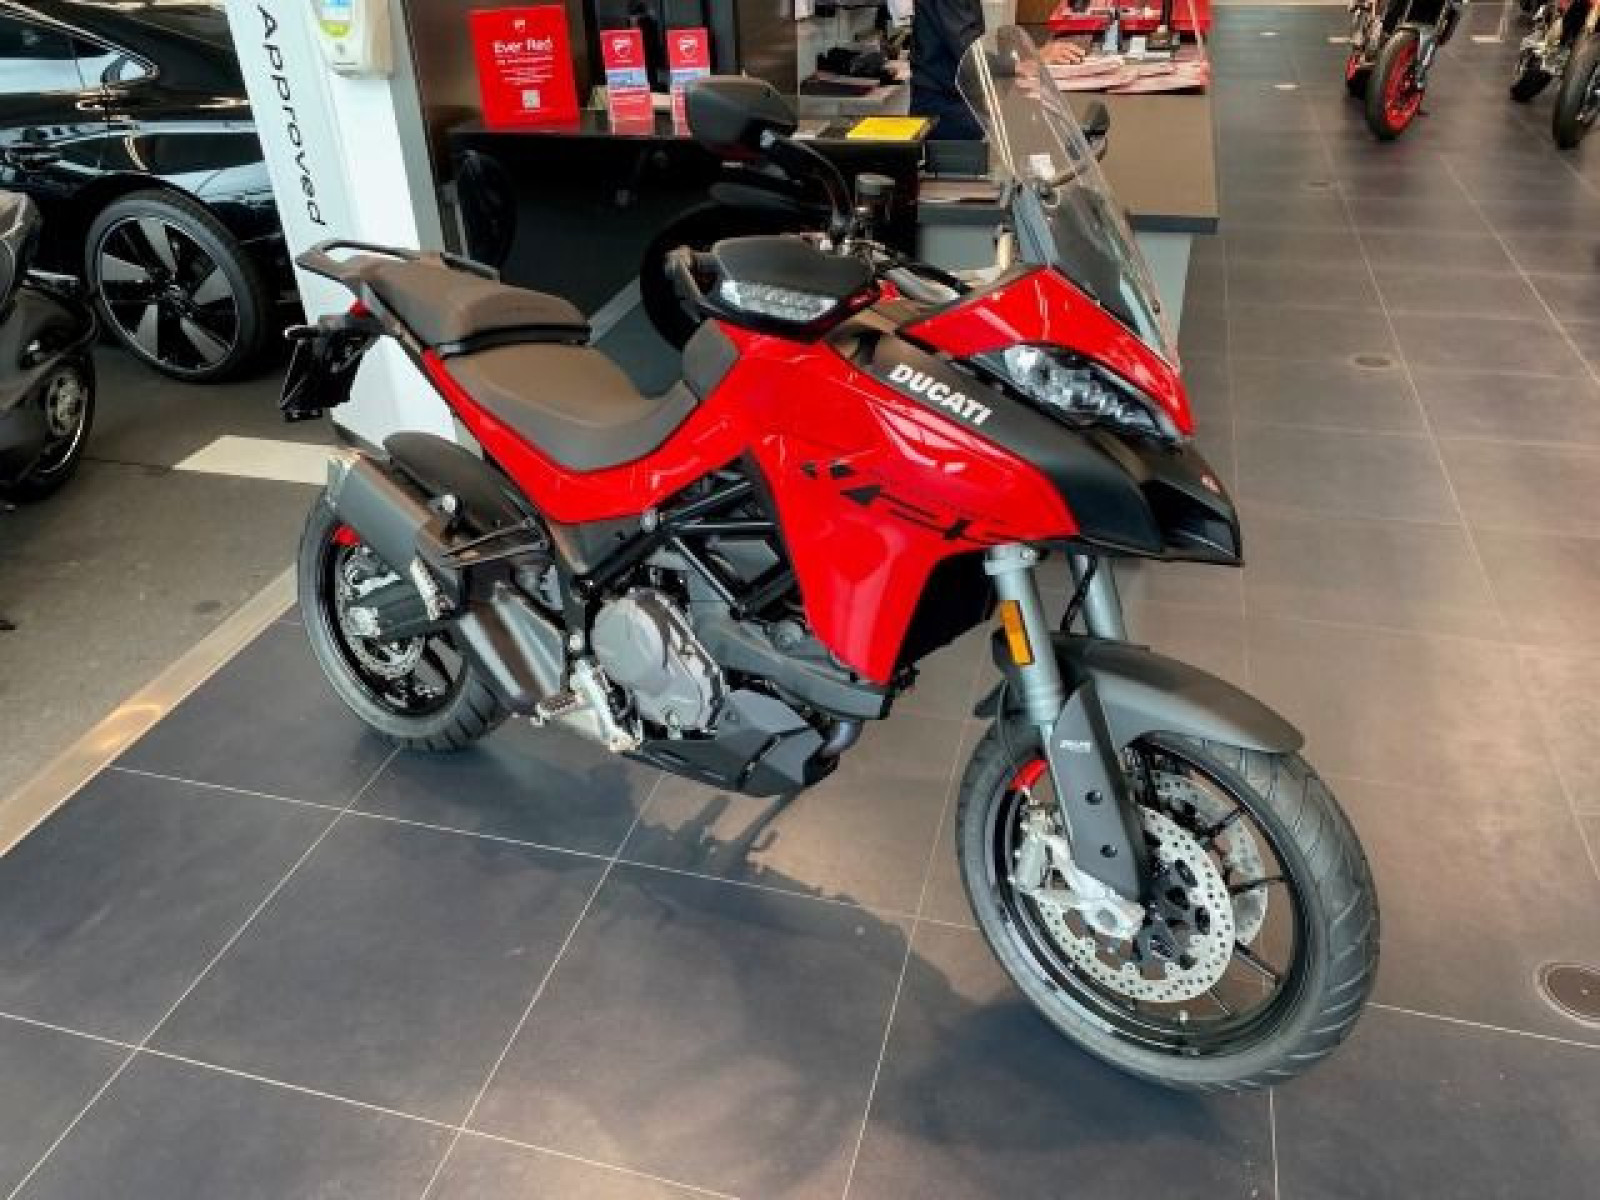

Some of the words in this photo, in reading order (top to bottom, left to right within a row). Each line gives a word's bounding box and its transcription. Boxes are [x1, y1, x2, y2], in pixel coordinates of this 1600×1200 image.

[493, 39, 522, 54] Ever
[526, 37, 553, 51] Red
[888, 363, 992, 425] DUCATI
